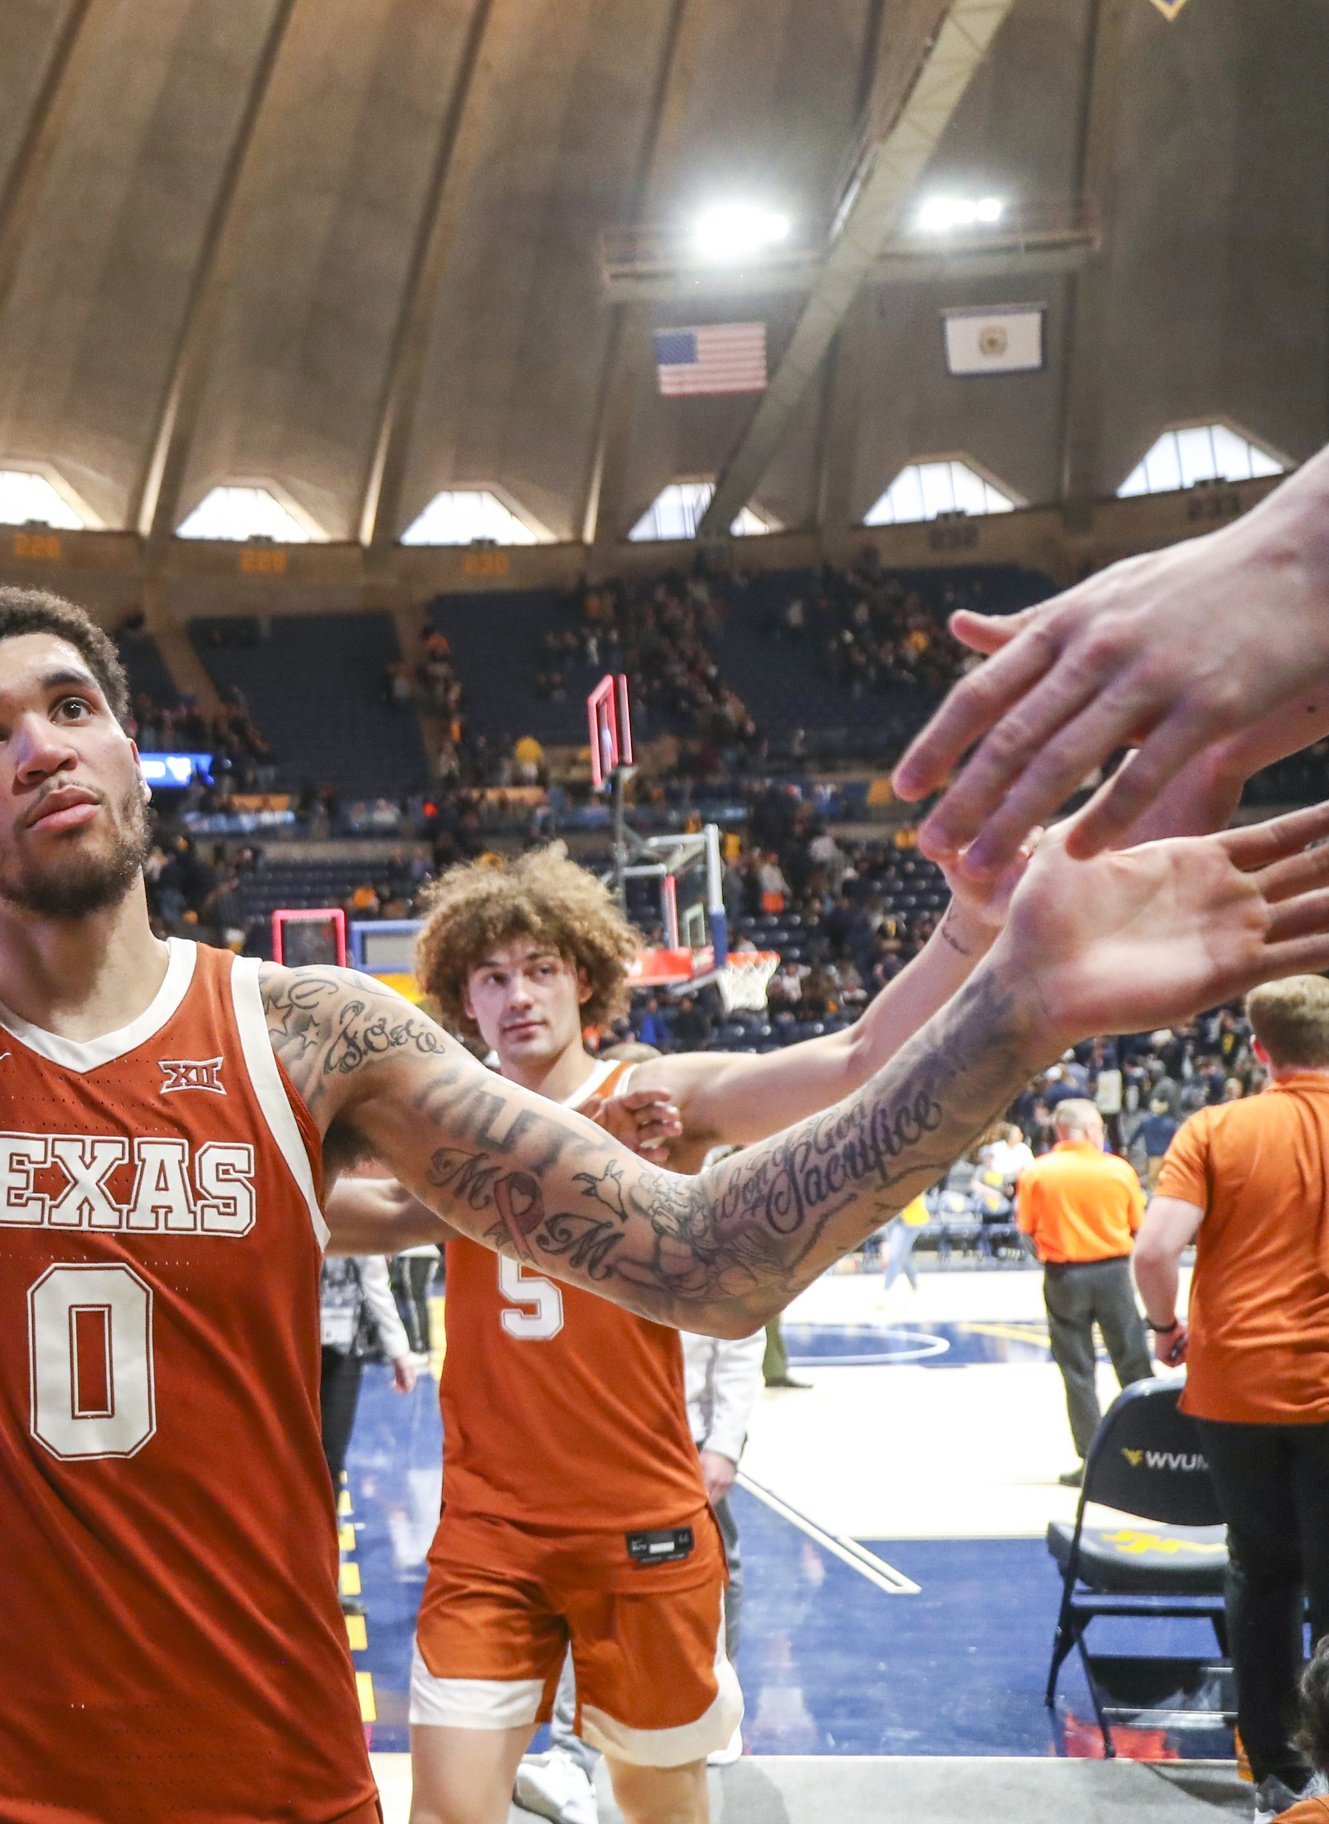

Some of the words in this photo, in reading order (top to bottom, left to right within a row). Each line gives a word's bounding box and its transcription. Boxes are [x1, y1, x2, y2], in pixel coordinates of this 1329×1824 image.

[766, 1089, 943, 1235] Sacrifice
[26, 1263, 157, 1462] 0
[498, 1253, 564, 1341] 5
